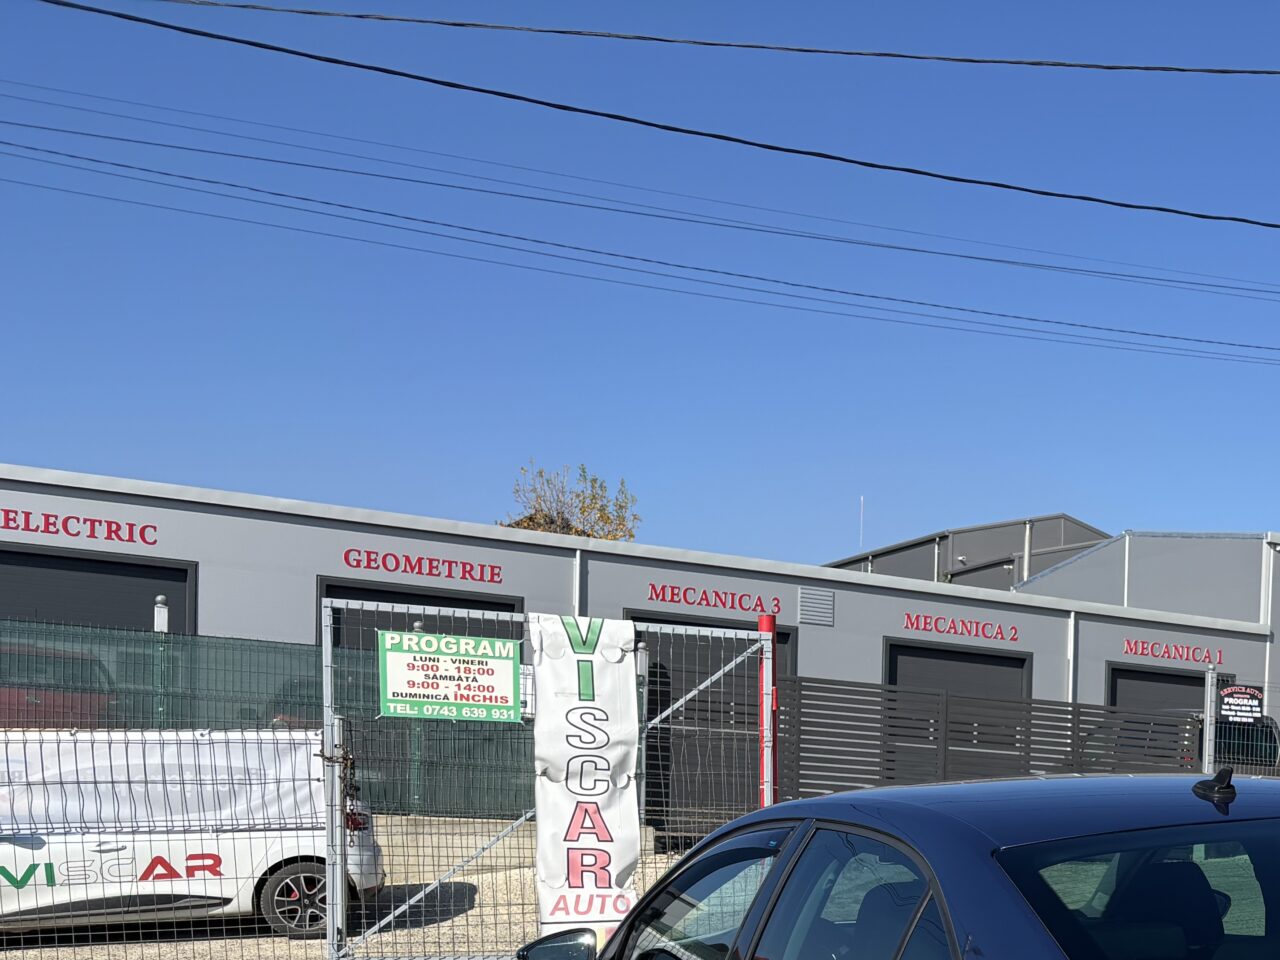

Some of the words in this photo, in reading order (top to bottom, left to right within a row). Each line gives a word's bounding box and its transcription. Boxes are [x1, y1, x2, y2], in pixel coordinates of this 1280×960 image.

[0, 508, 158, 545] ELECTRIC
[343, 548, 503, 584] GEOMETRIE
[648, 583, 766, 613] MECANICA
[771, 597, 782, 614] 3
[903, 612, 1006, 641] MECANICA
[1009, 626, 1019, 642] 2
[385, 633, 514, 658] PROGRAM
[1123, 638, 1213, 664] MECANICA
[1216, 648, 1223, 665] 1
[406, 662, 440, 673] 9:00
[454, 666, 495, 677] 18:00
[413, 655, 440, 664] LUNI
[450, 658, 488, 667] VINERI
[406, 680, 440, 690] 9:00
[454, 683, 495, 694] 14:00
[423, 704, 457, 717] 0743
[462, 707, 487, 718] 639
[491, 709, 515, 719] 931
[1224, 697, 1259, 706] PROGRAM
[560, 615, 614, 889] VISCAR
[0, 853, 225, 889] VISCAR
[549, 894, 632, 917] AUTO
